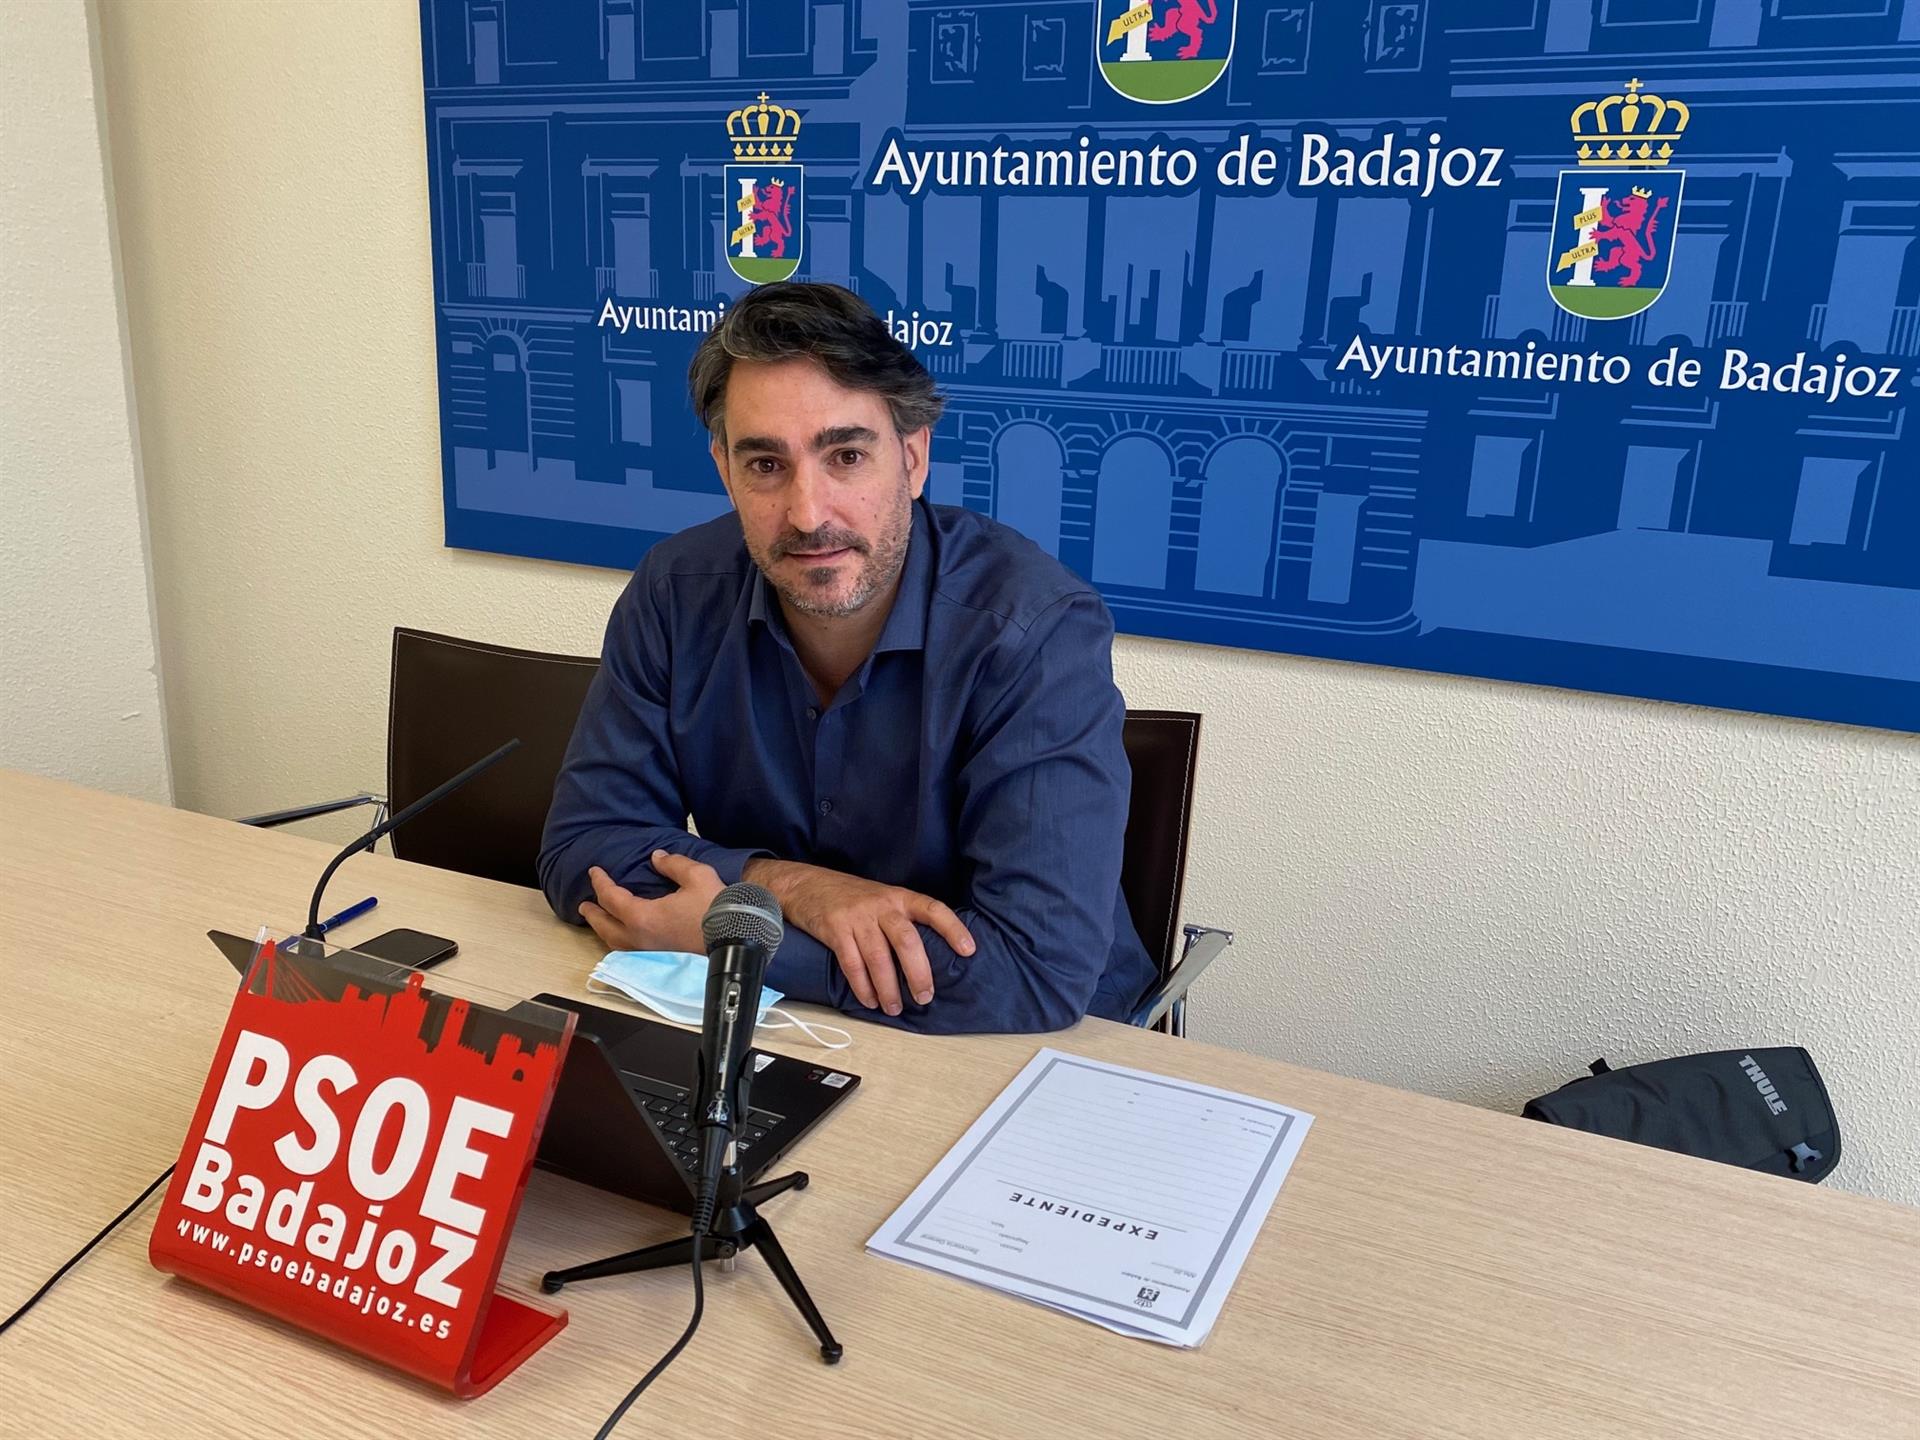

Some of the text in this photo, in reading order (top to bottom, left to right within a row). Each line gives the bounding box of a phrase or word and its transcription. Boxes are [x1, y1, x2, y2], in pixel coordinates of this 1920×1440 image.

[1122, 9, 1151, 28] ULTRA
[872, 133, 1505, 197] Ayuntamiento de Badajoz
[1579, 212, 1597, 224] PLUS
[1571, 246, 1597, 260] ULTRA
[597, 298, 725, 334] Ayuntami
[1336, 335, 1901, 403] Ayuntamiento de Badajoz
[1738, 1055, 1787, 1116] THULE
[204, 1029, 515, 1236] PSOE
[181, 1142, 477, 1309] Badajoz
[1009, 1192, 1159, 1240] EXPEDIENTE
[177, 1218, 451, 1340] www.psoebadajoz.es
